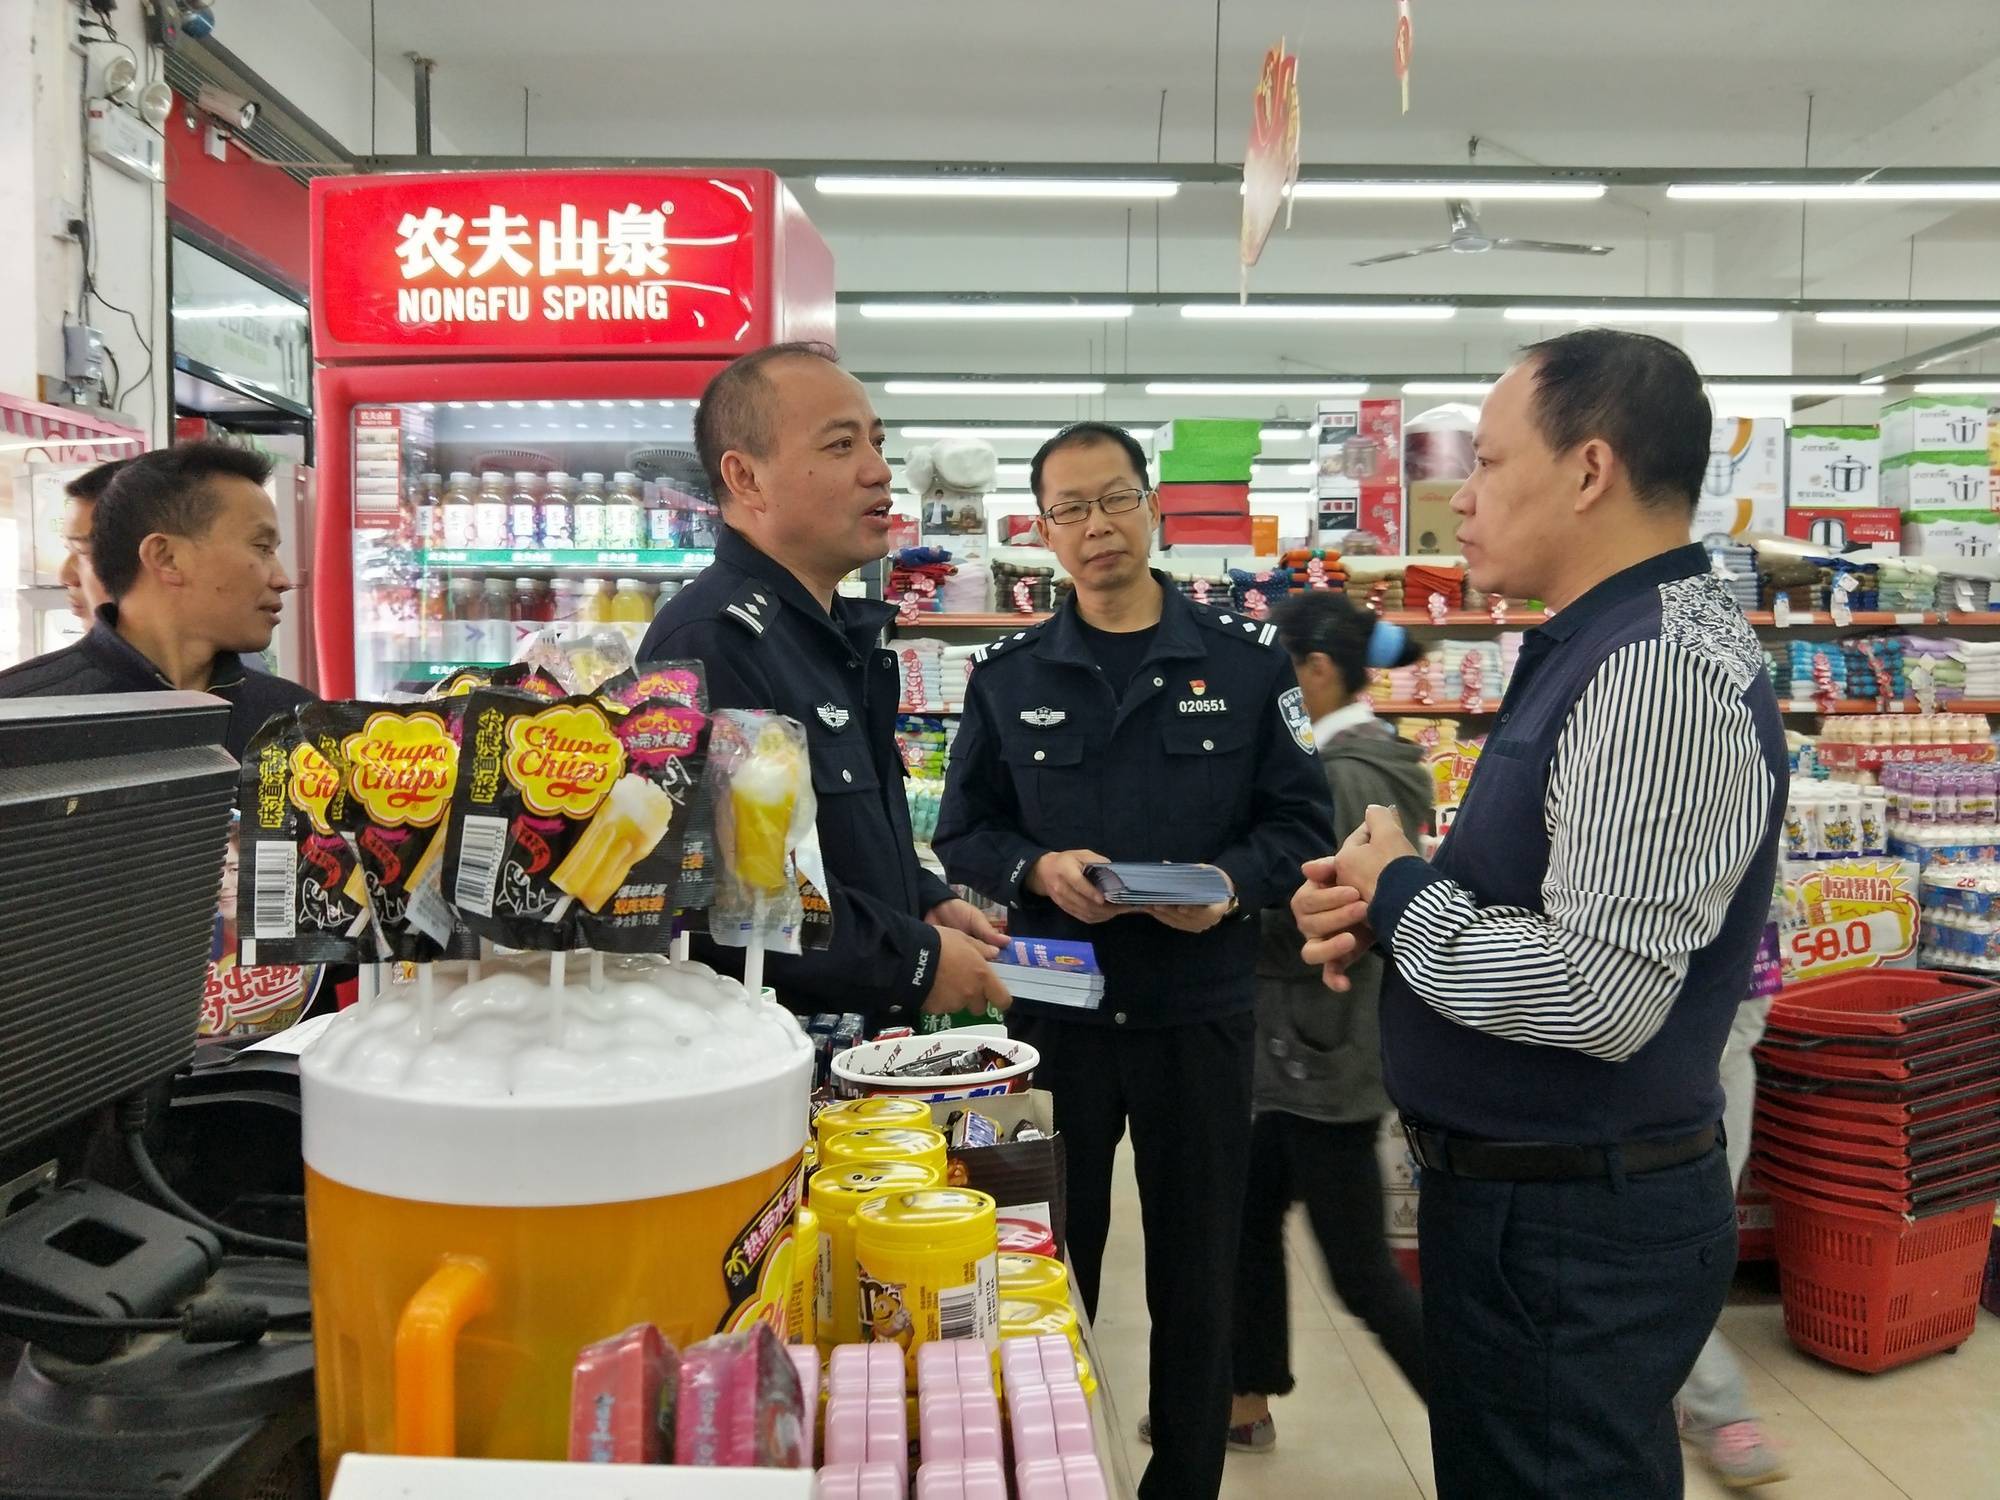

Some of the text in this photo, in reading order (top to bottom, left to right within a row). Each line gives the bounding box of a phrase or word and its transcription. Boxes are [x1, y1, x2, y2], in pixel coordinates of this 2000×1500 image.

[395, 203, 670, 279] 农夫山泉
[398, 285, 669, 323] NONGFU SPRING
[1178, 699, 1227, 714] 020551
[361, 739, 448, 767] Chupa
[470, 707, 504, 803] 味道满分
[524, 725, 612, 758] Chupa
[361, 763, 449, 808] Chups
[516, 749, 608, 798] Chups
[1010, 859, 1026, 883] POLICE
[1821, 875, 1893, 902] 惊爆价
[1791, 920, 1872, 967] 58.0
[912, 948, 930, 986] POLICE
[923, 1014, 952, 1032] 清爽
